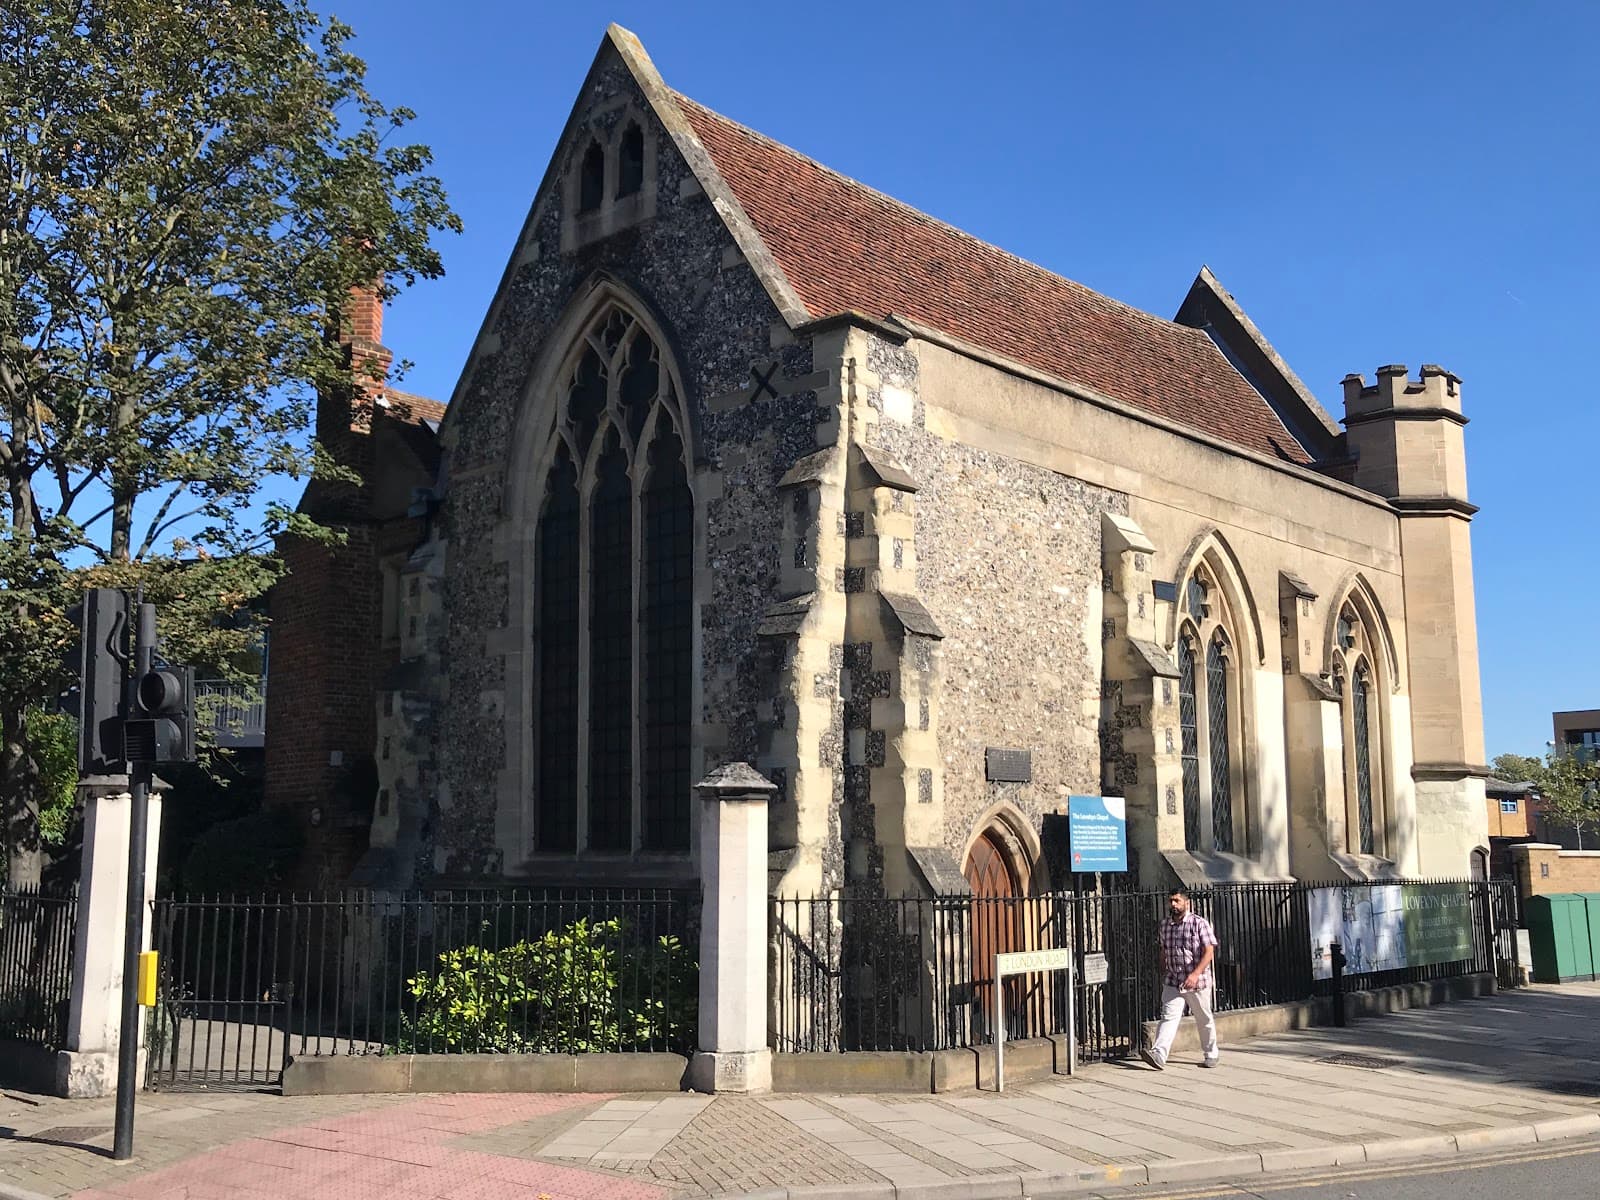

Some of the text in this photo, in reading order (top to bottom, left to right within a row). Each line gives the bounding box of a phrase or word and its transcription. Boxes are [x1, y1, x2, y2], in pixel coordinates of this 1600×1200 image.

[1405, 893, 1468, 910] LOVEKYN CHAPEL
[1011, 954, 1043, 969] LONDON
[1045, 952, 1066, 966] ROAD
